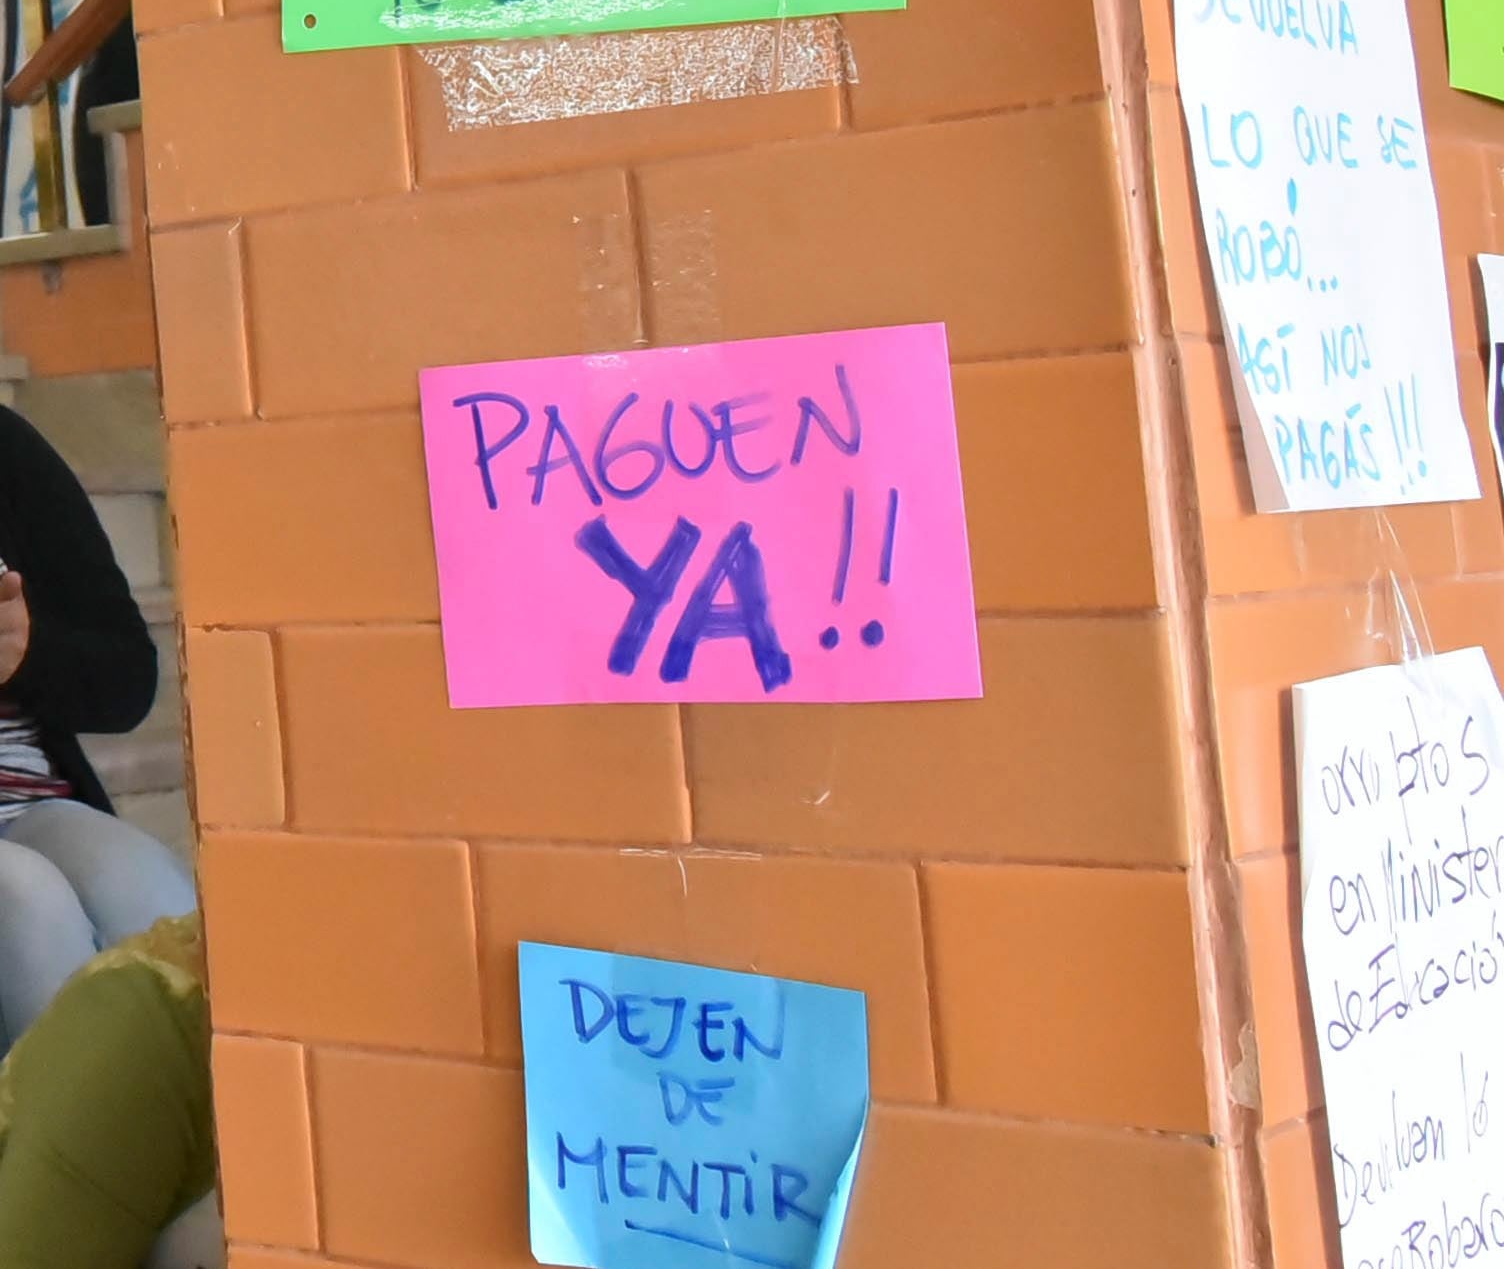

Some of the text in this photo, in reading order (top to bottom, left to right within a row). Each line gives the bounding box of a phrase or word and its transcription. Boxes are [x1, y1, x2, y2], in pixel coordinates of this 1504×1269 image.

[1201, 103, 1262, 169] LO
[1294, 105, 1359, 168] QUE
[1321, 322, 1371, 387] NOS
[453, 363, 860, 510] PAGUEN
[1329, 873, 1377, 936] en
[558, 978, 787, 1062] DEJEN
[657, 1070, 735, 1127] DE
